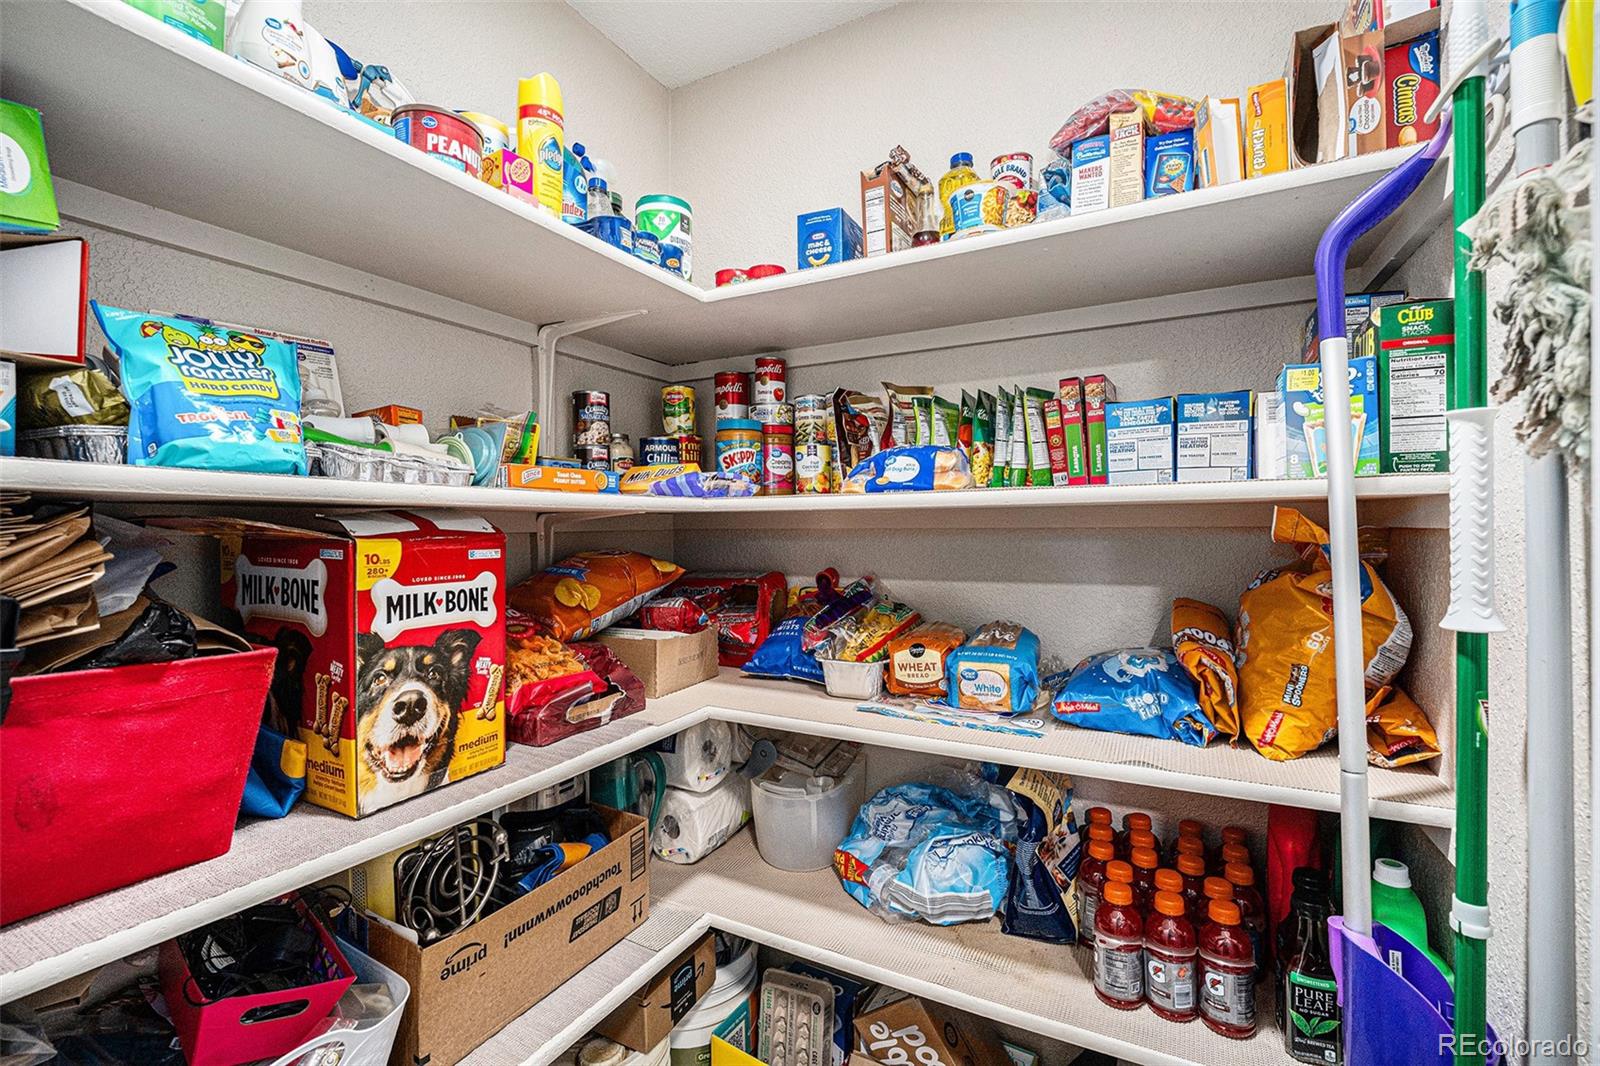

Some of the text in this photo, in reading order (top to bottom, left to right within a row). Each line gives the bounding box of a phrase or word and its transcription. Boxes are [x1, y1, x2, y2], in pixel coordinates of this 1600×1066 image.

[1251, 128, 1267, 170] CRUNCH
[1005, 163, 1028, 179] BRAND
[1397, 307, 1434, 324] CLUB
[170, 345, 256, 370] JOLLY
[181, 364, 272, 382] rancher
[189, 381, 273, 394] HARD CANDY
[176, 411, 251, 423] TROPCAL
[644, 444, 677, 452] ARMOUR
[679, 450, 700, 461] hili
[646, 453, 671, 463] Chili
[722, 450, 756, 469] SKIPPY
[524, 469, 541, 480] Lance
[626, 465, 685, 483] Milk Duds
[364, 553, 380, 565] 10
[241, 573, 319, 616] MILK BONE
[386, 587, 489, 625] MILK BONE
[897, 662, 938, 672] WHEAT
[974, 683, 1002, 693] White
[1283, 665, 1309, 707] MINI SPOONERS
[459, 732, 499, 753] medium
[306, 757, 345, 780] medium
[503, 861, 623, 949] Touchdooowwwnnn!
[440, 943, 488, 981] prime
[1296, 976, 1330, 988] UNSWEETENED
[1295, 986, 1334, 1002] PURE
[1295, 996, 1335, 1012] LEAF
[1310, 1009, 1329, 1017] SUGAR
[1307, 1039, 1326, 1048] BREWED
